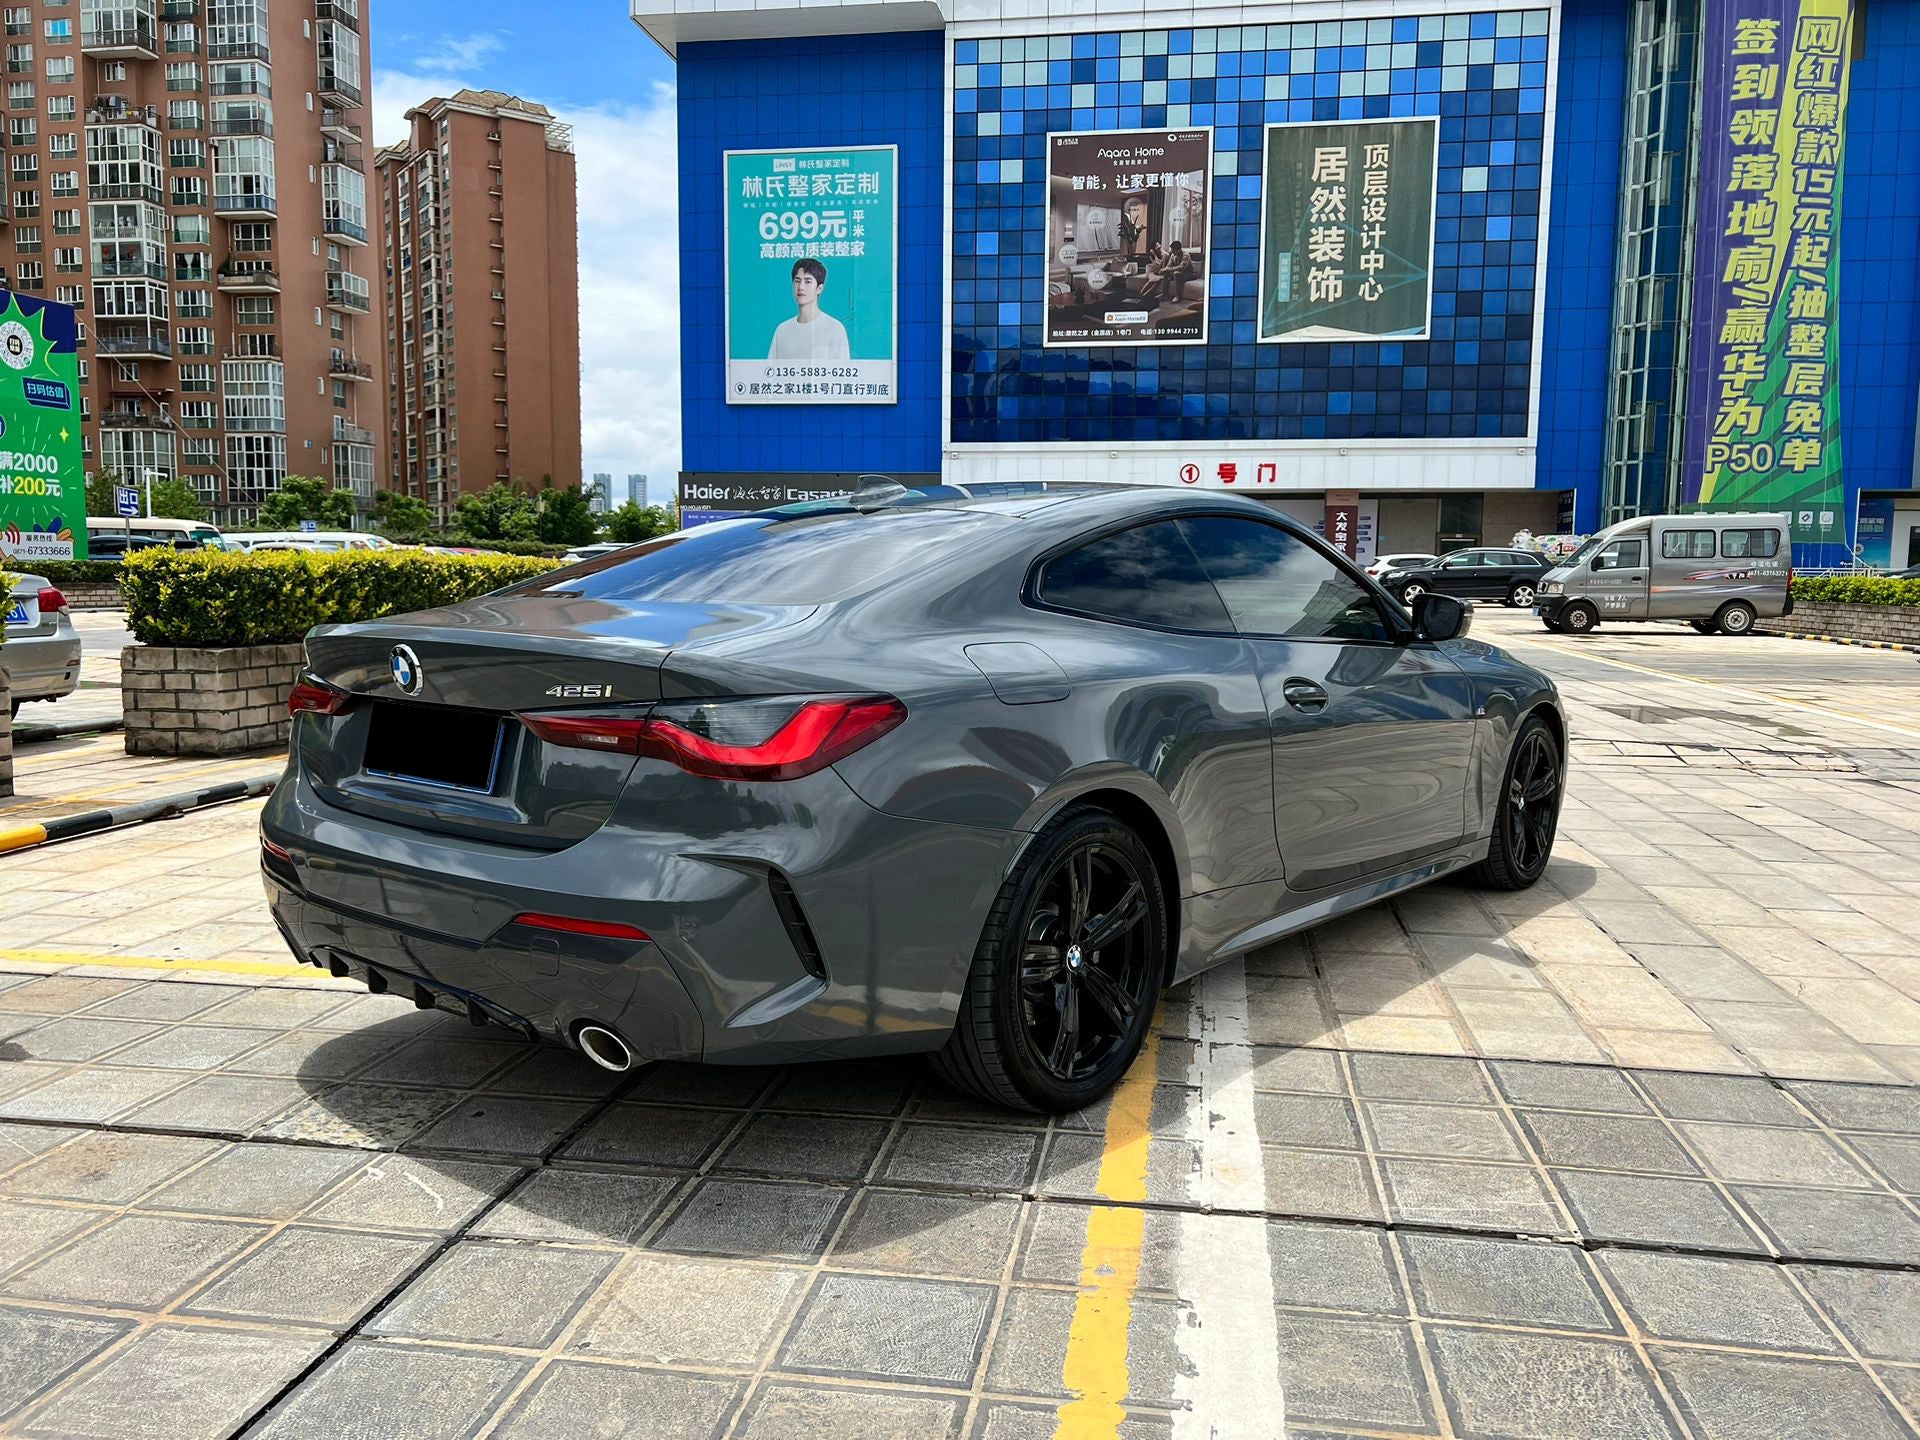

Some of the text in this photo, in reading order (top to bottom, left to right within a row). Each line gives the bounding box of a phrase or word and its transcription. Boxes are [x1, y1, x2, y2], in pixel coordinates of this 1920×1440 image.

[1097, 147, 1164, 159] Aqara Home
[742, 171, 879, 198] 林氏整家定制
[759, 211, 847, 240] 699元
[1307, 146, 1349, 303] 居然装饰
[1358, 143, 1390, 302] 顶层设计中心
[760, 240, 865, 259] 高颜高质装整家
[776, 366, 859, 378] 136-5883-6282
[27, 382, 64, 398] 扫码估值
[749, 382, 889, 396] 居然之家1楼1号门直行到底
[1705, 443, 1774, 472] P50
[684, 483, 730, 500] Haier
[26, 534, 52, 542] 服务热线
